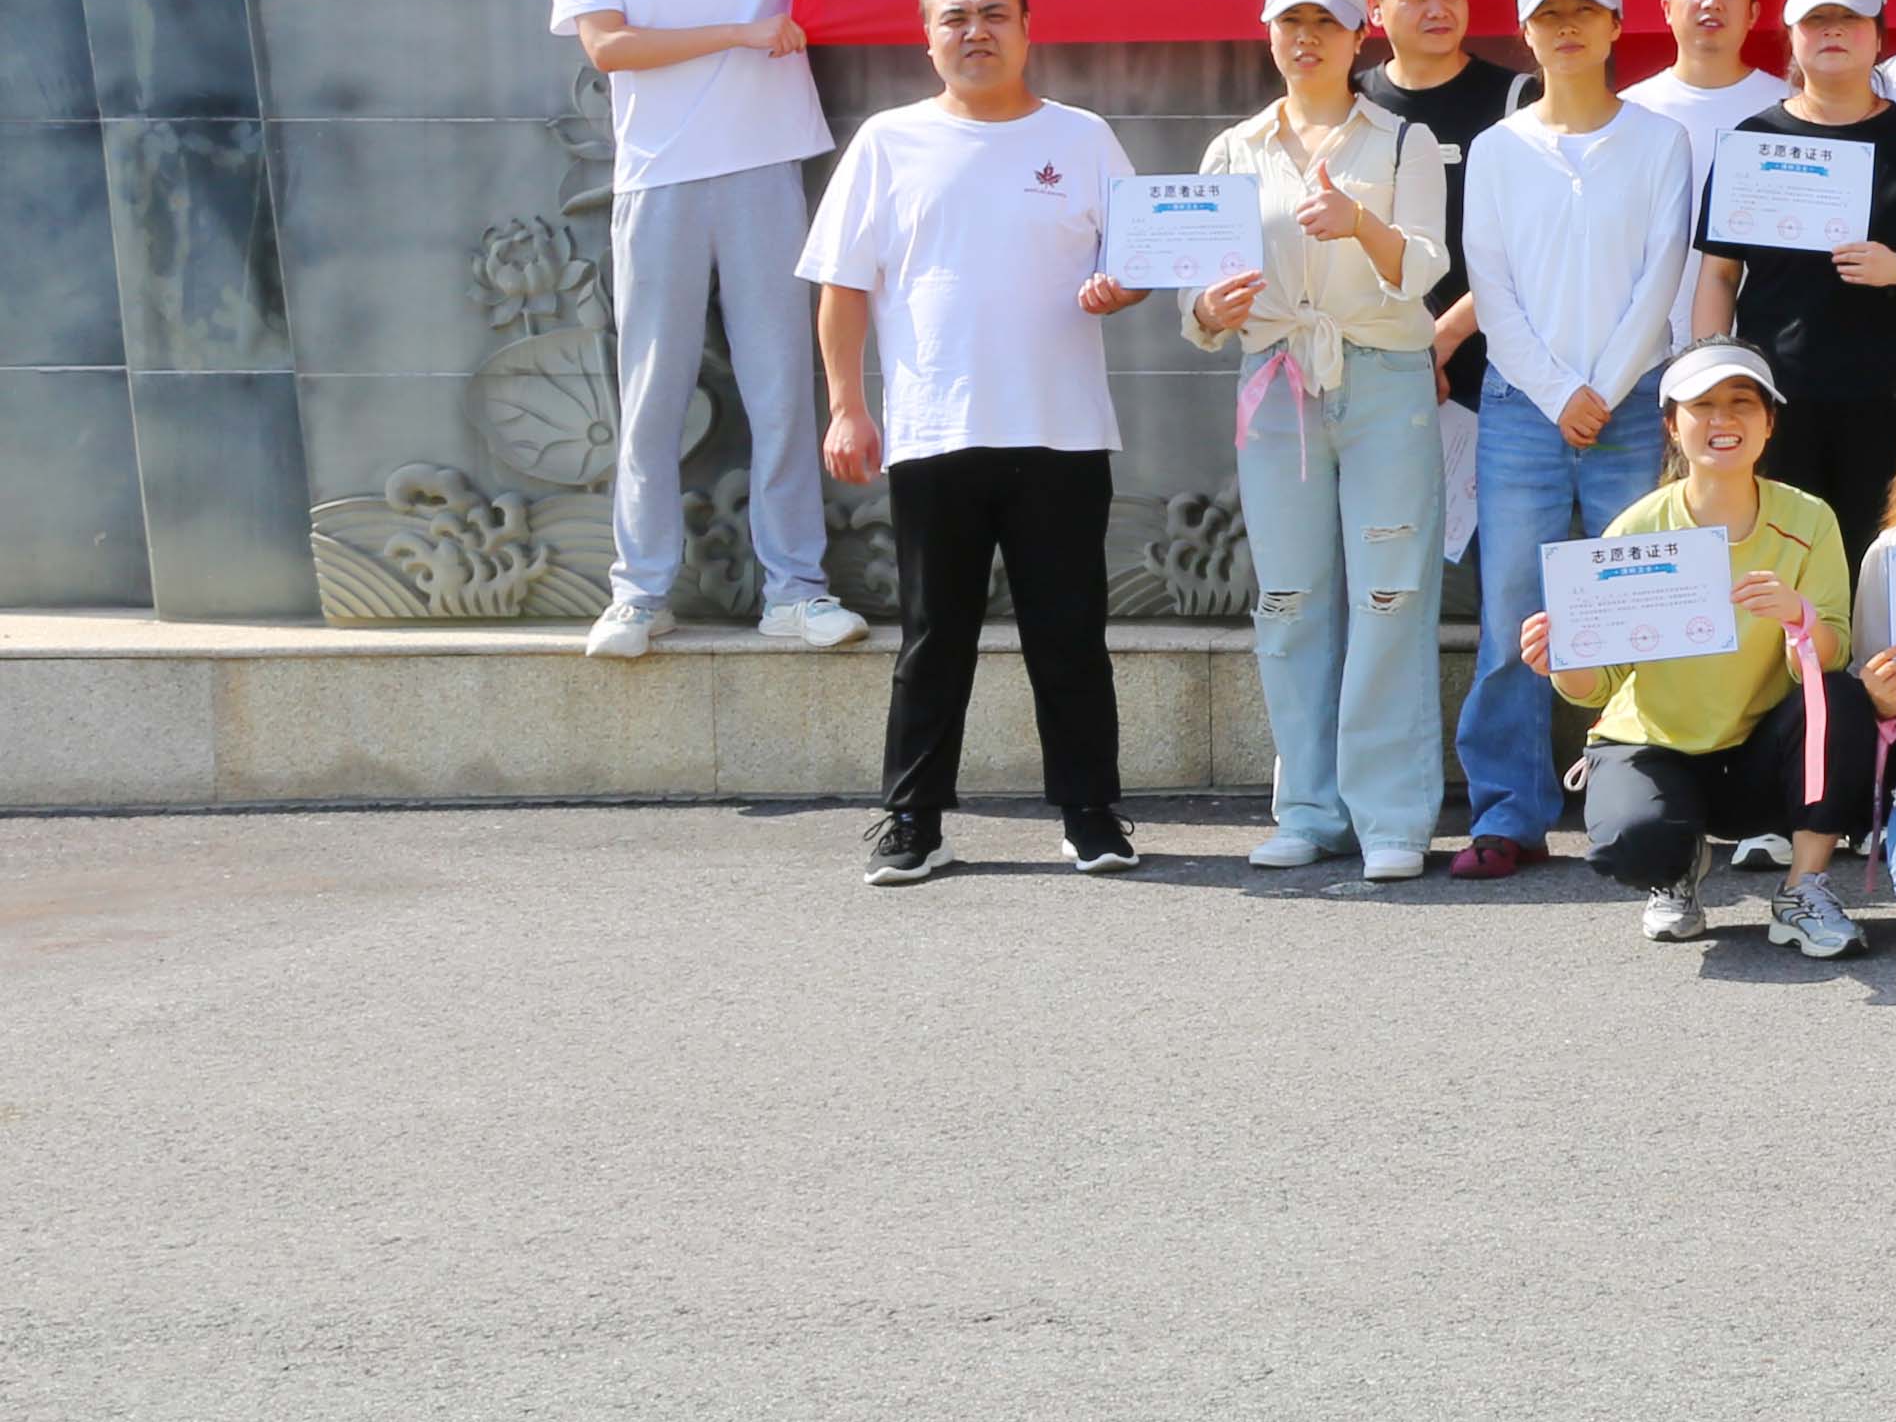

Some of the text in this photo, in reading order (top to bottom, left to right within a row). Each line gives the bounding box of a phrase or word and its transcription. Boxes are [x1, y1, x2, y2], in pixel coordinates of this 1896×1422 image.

[1760, 143, 1832, 161] 志愿者证书
[1150, 185, 1220, 198] 志愿者证书
[1592, 542, 1678, 564] 志愿者证书
